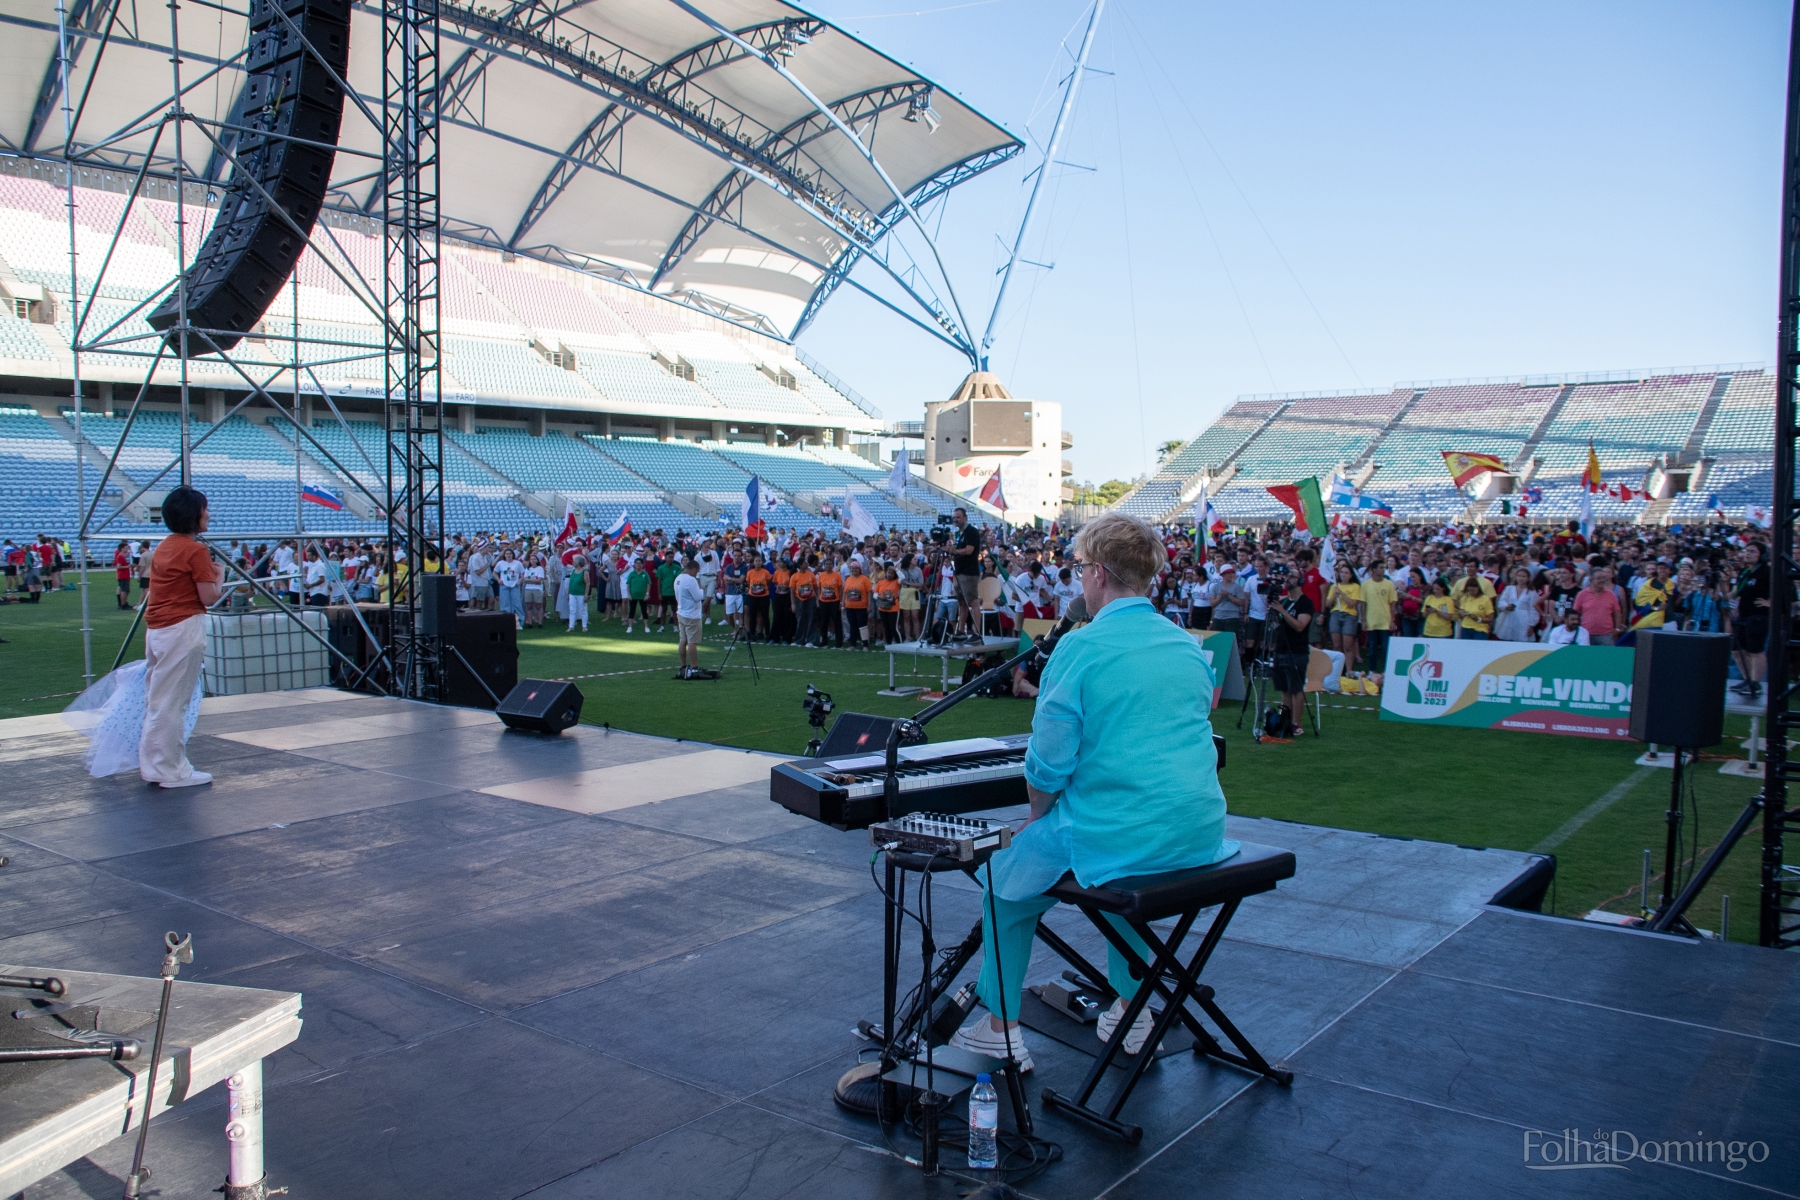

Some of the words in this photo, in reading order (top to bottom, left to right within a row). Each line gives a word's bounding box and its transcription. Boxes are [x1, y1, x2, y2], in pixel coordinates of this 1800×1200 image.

[455, 392, 476, 402] FARO
[973, 467, 994, 477] Faro
[1425, 679, 1449, 693] JMJ
[1423, 698, 1447, 706] 2023
